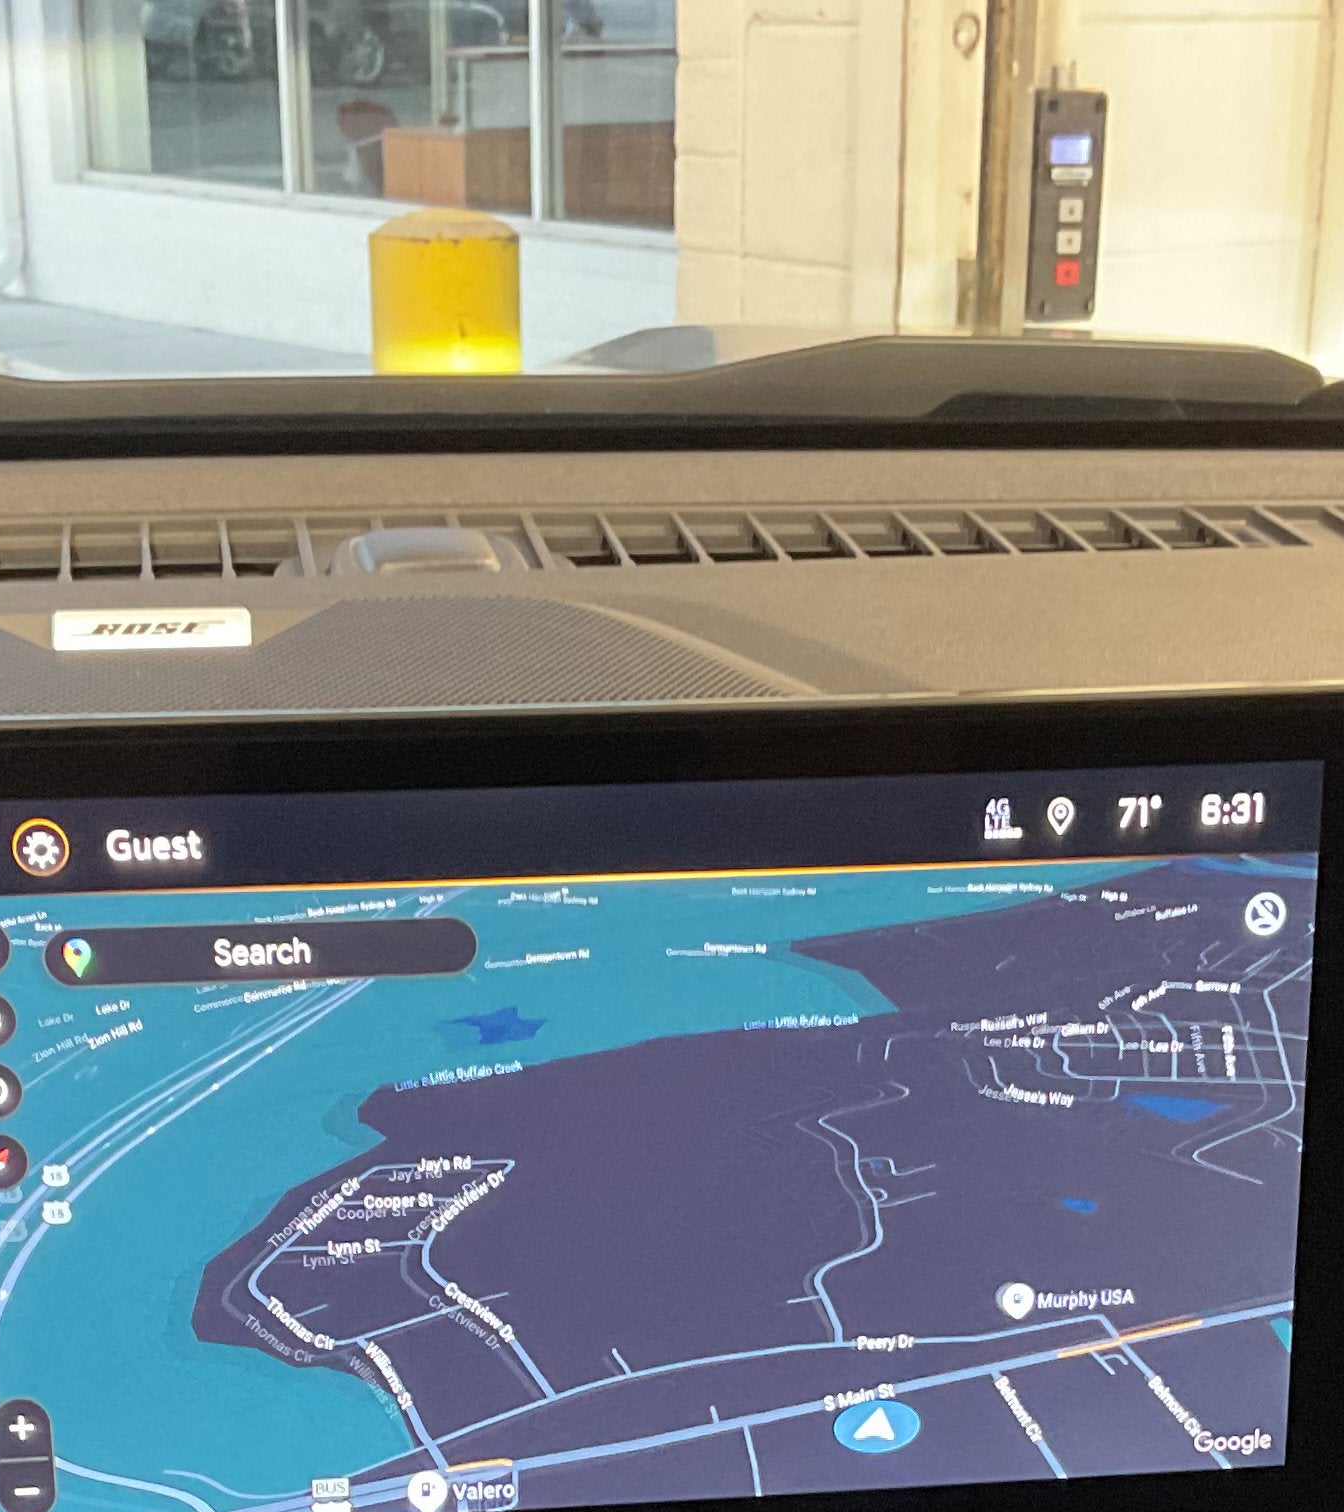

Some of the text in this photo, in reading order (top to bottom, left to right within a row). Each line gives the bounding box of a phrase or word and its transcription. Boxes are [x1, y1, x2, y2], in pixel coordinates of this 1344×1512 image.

[986, 798, 1010, 815] 4G
[1118, 795, 1162, 829] 71°
[985, 814, 1010, 829] LTE
[106, 829, 203, 861] Guest
[213, 936, 312, 967] Search
[95, 1000, 131, 1016] Lake Dr
[110, 1022, 127, 1041] Hill
[127, 1018, 144, 1035] Rd
[1012, 1034, 1046, 1049] Lee Dr
[1048, 1091, 1074, 1108] Way
[416, 1155, 472, 1174] Jay's Rd
[296, 1176, 362, 1236] Thomas Cir
[363, 1192, 434, 1211] Cooper St
[430, 1169, 506, 1232] Crestview Dr
[327, 1238, 381, 1257] Lynn St
[1037, 1287, 1134, 1310] Murphy USA
[267, 1295, 336, 1351] Thomas Cir
[444, 1282, 516, 1343] Crestview Dr
[857, 1333, 914, 1352] Peery Dr
[365, 1340, 413, 1411] Williams St
[823, 1383, 896, 1411] S Main St
[1148, 1375, 1190, 1424] Belmont
[994, 1375, 1044, 1443] Belmont Cir
[1194, 1428, 1272, 1455] Google
[315, 1481, 346, 1496] BUS
[452, 1481, 516, 1501] Valero
